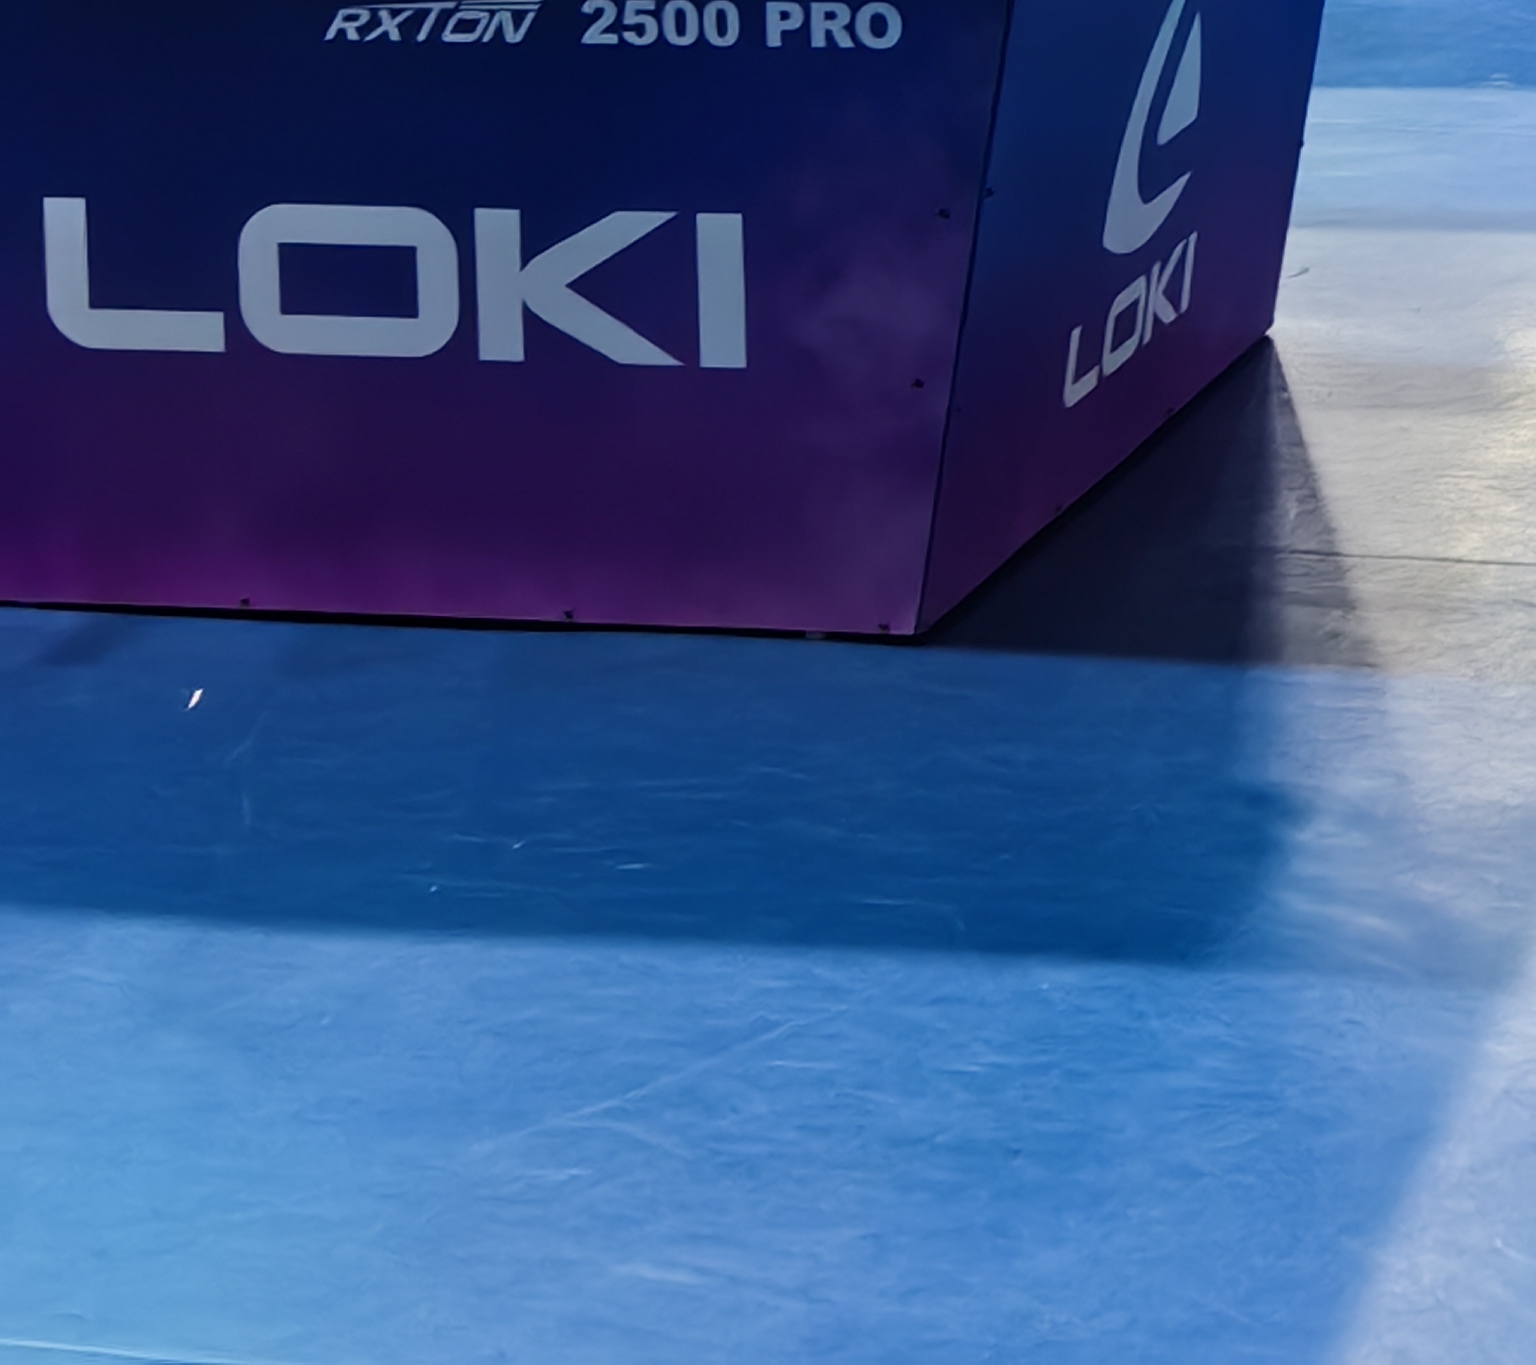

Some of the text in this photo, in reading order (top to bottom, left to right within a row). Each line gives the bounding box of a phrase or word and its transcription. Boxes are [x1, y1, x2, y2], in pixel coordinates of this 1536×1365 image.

[765, 1, 903, 49] PRO
[43, 197, 748, 369] LOKI
[1063, 230, 1198, 409] LOKI
